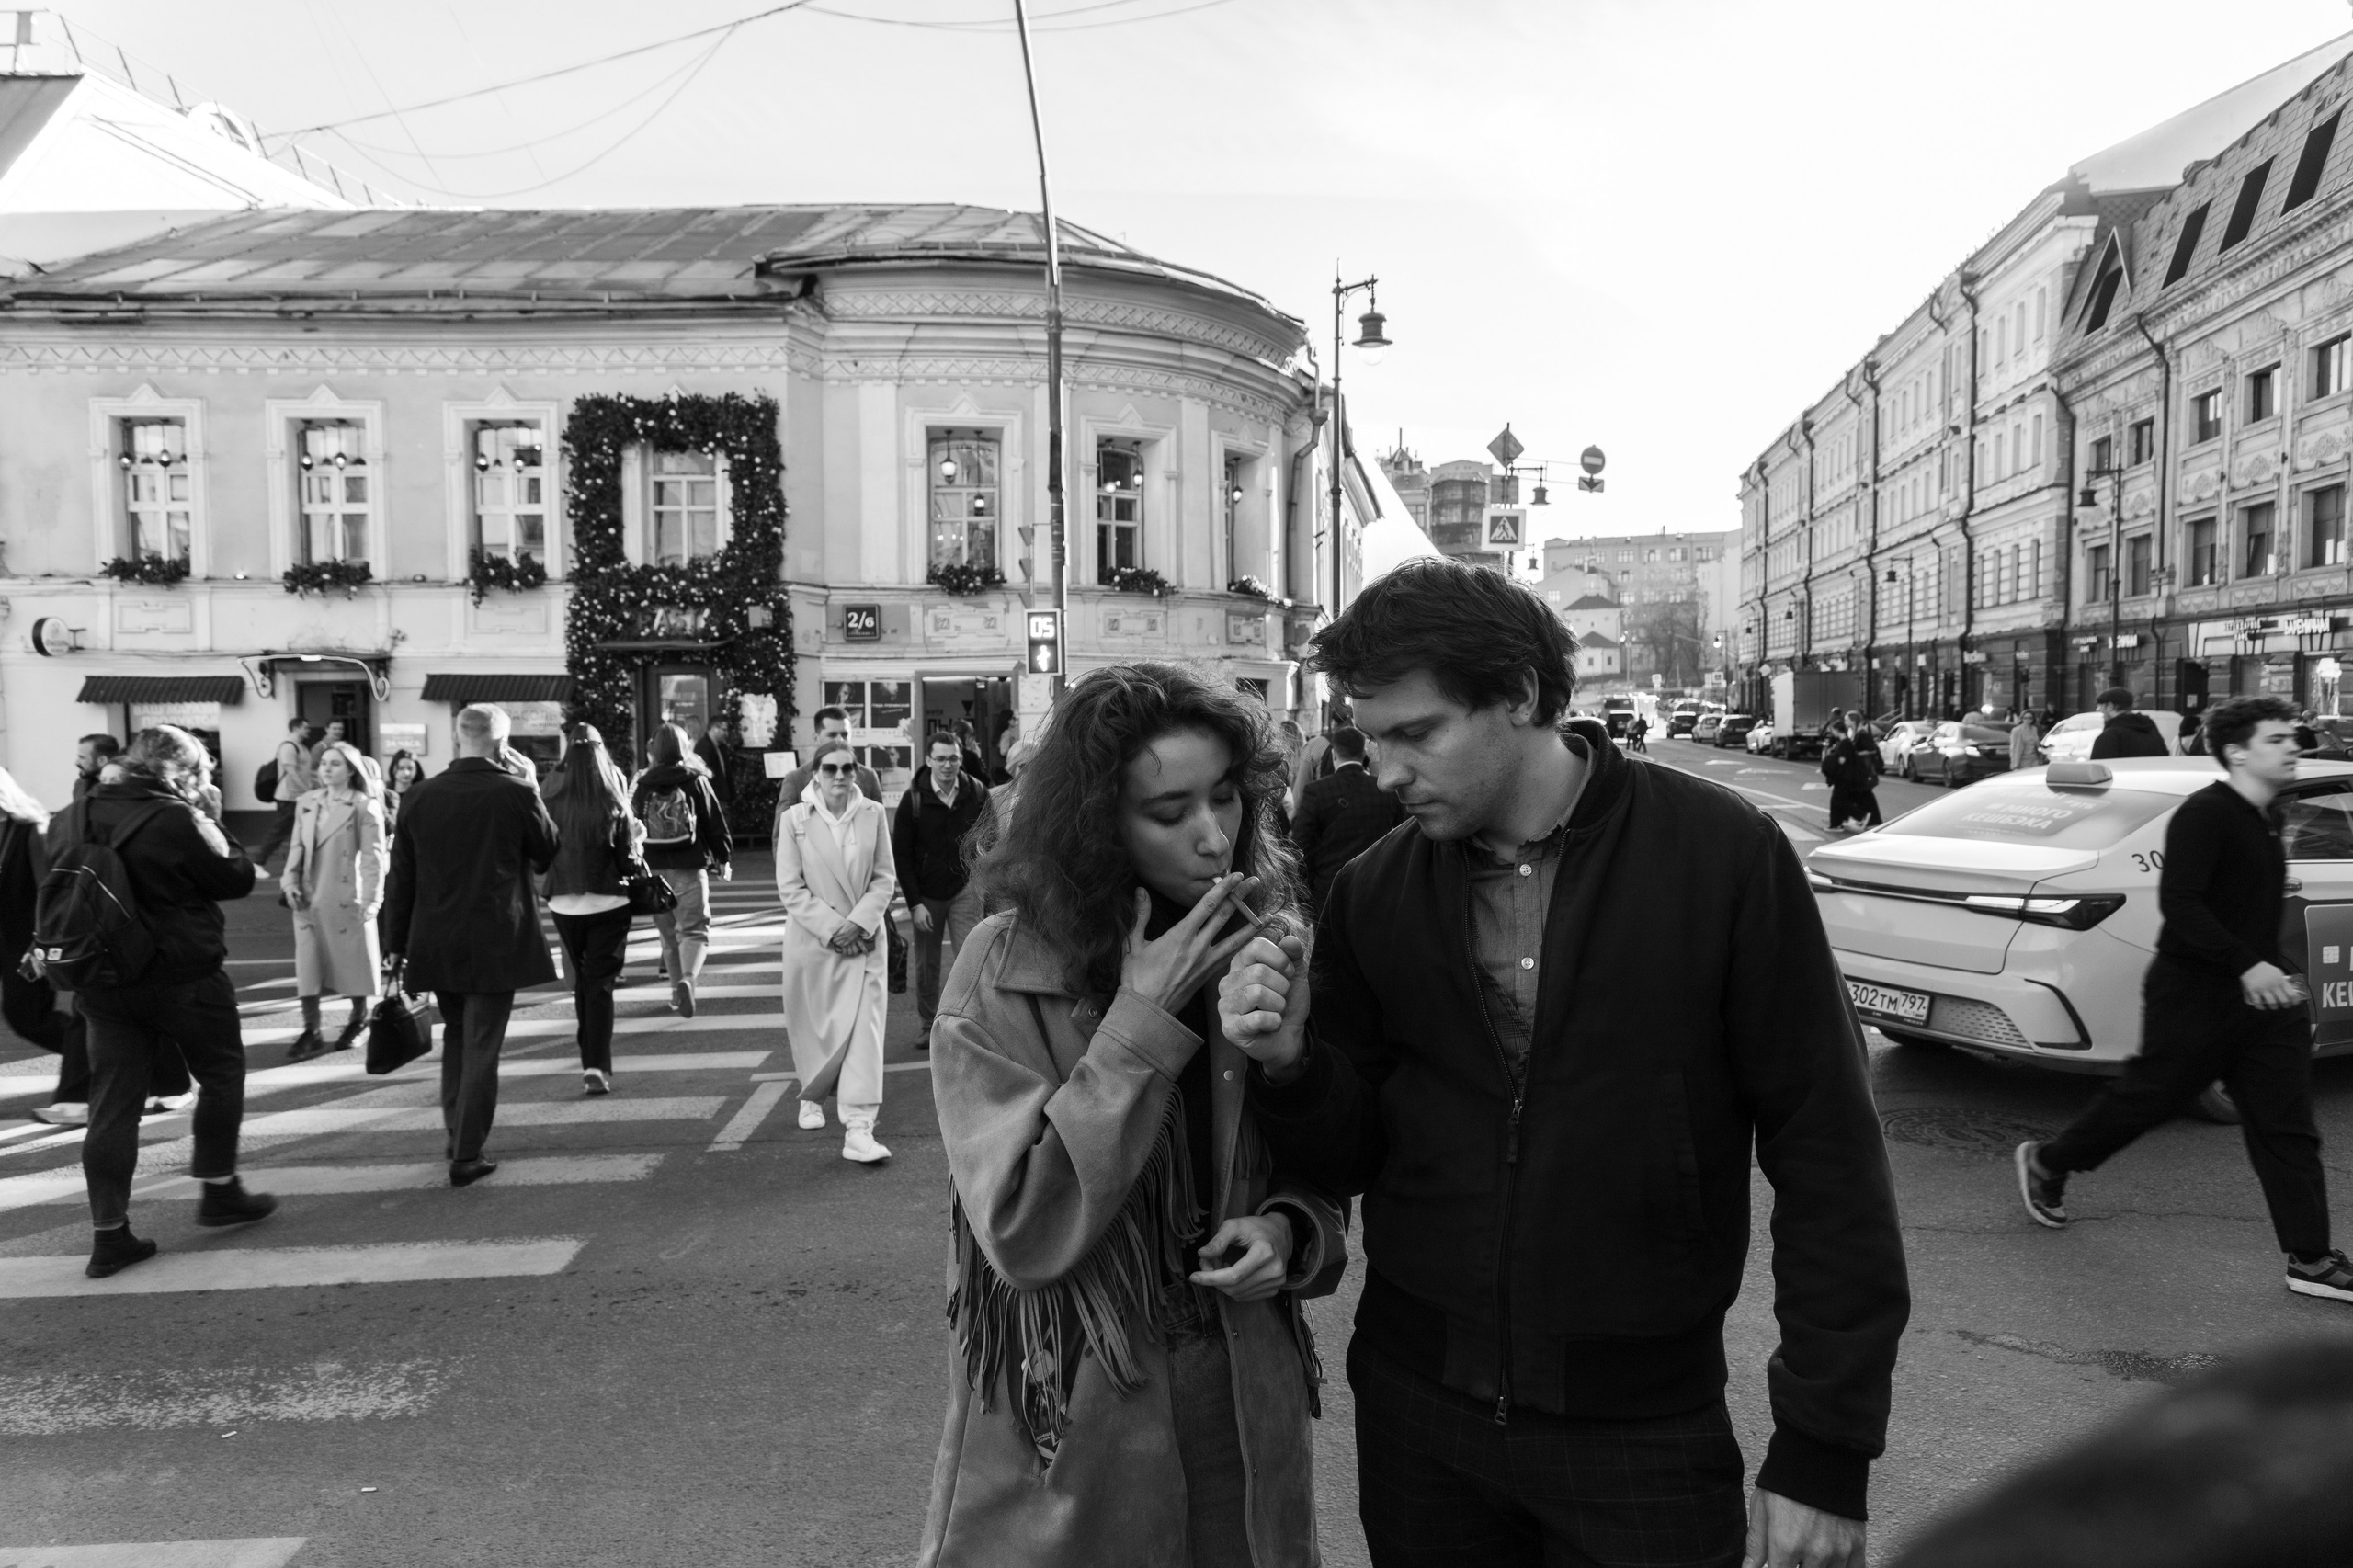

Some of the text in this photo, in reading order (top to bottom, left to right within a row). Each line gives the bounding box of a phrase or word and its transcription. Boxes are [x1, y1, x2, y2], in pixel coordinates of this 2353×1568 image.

[847, 611, 875, 630] 2/6
[1030, 617, 1055, 637] 05
[1961, 812, 2052, 829] КЕШБЭКА
[2000, 804, 2073, 819] МНОГО
[1849, 984, 1926, 1011] 302ТМ 797
